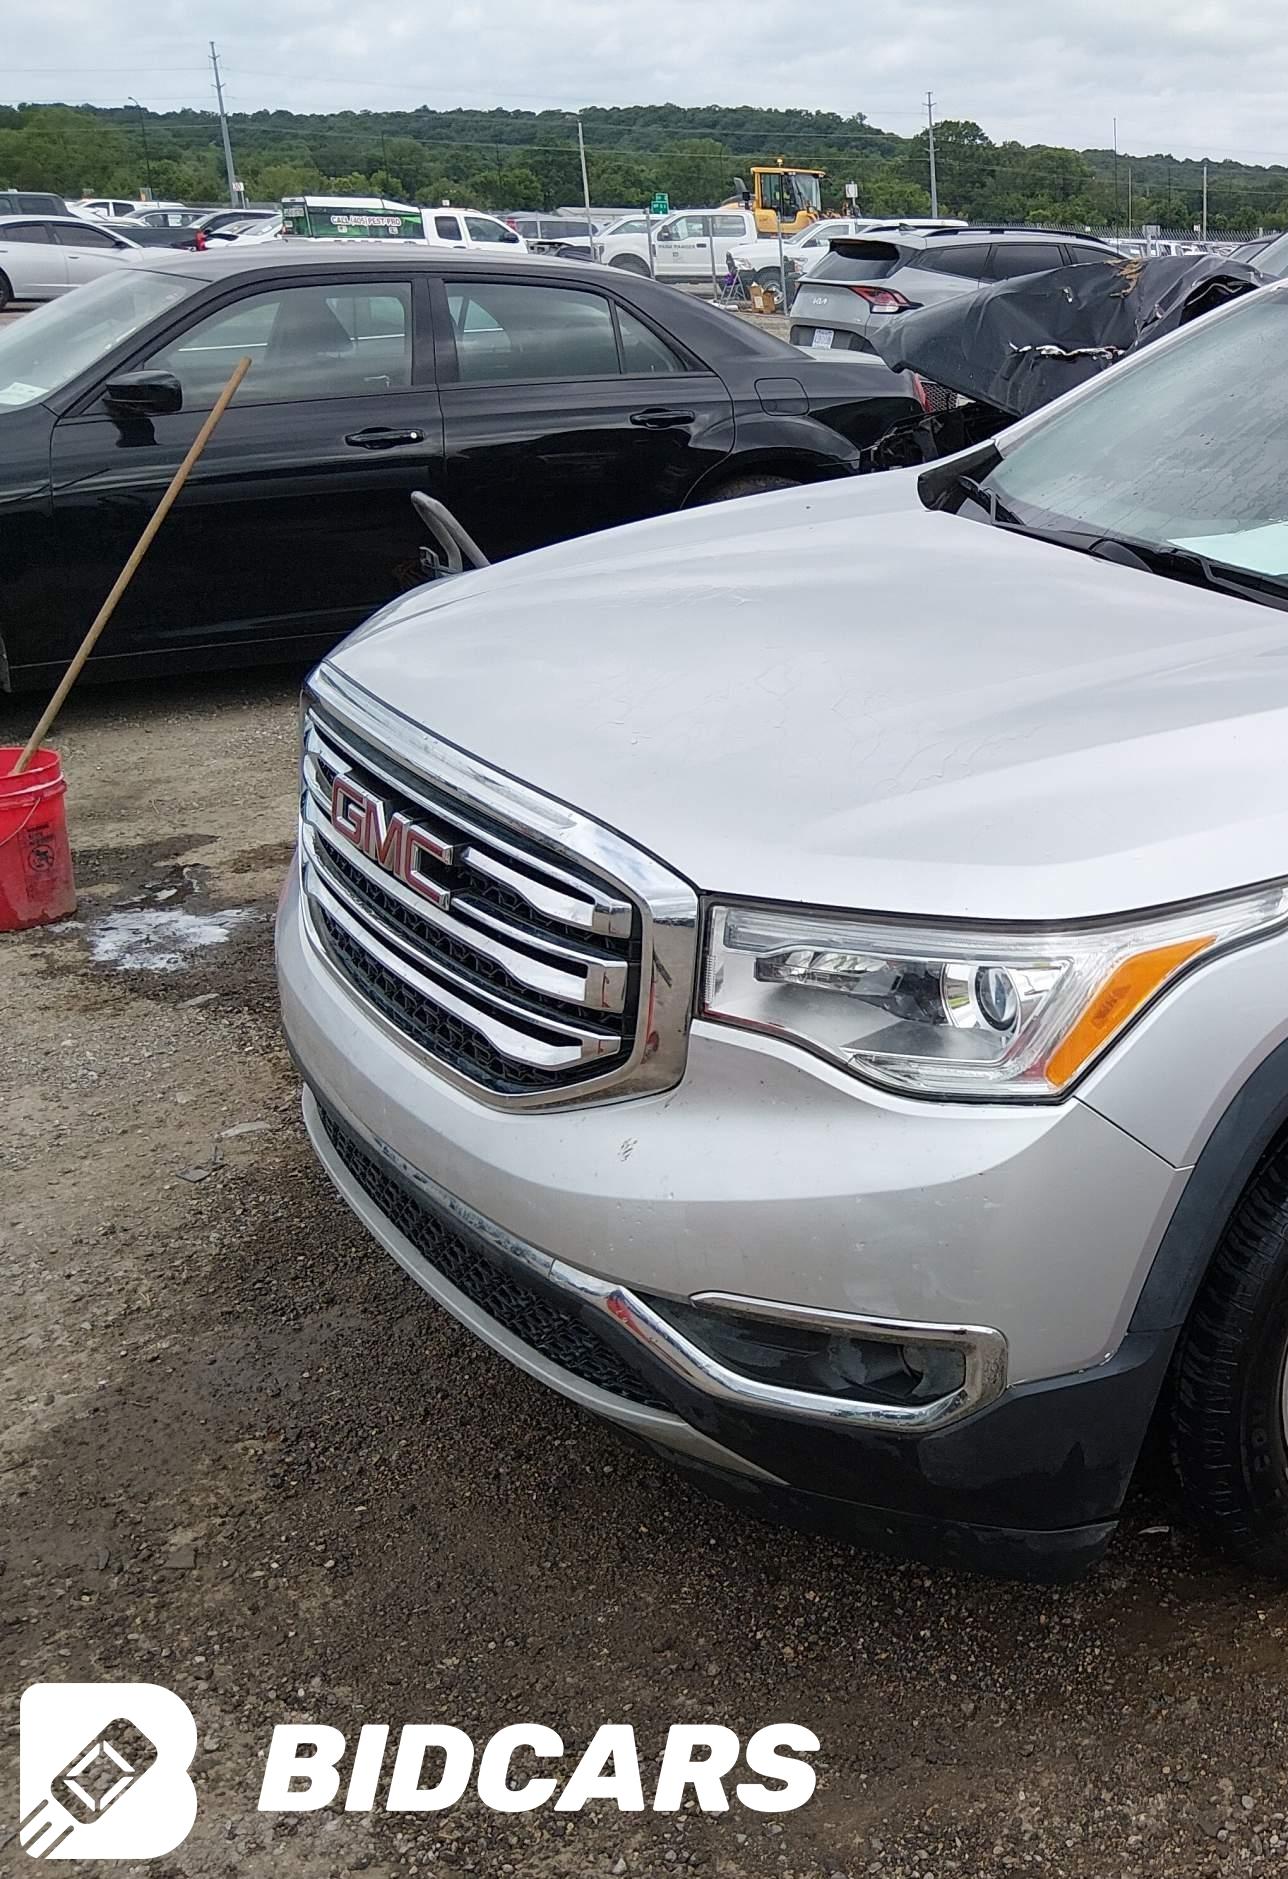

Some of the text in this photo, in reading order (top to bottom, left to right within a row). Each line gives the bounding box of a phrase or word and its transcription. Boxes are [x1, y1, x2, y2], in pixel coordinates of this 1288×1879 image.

[331, 215, 349, 225] CALL
[368, 216, 385, 226] PEST
[332, 773, 454, 911] GMC
